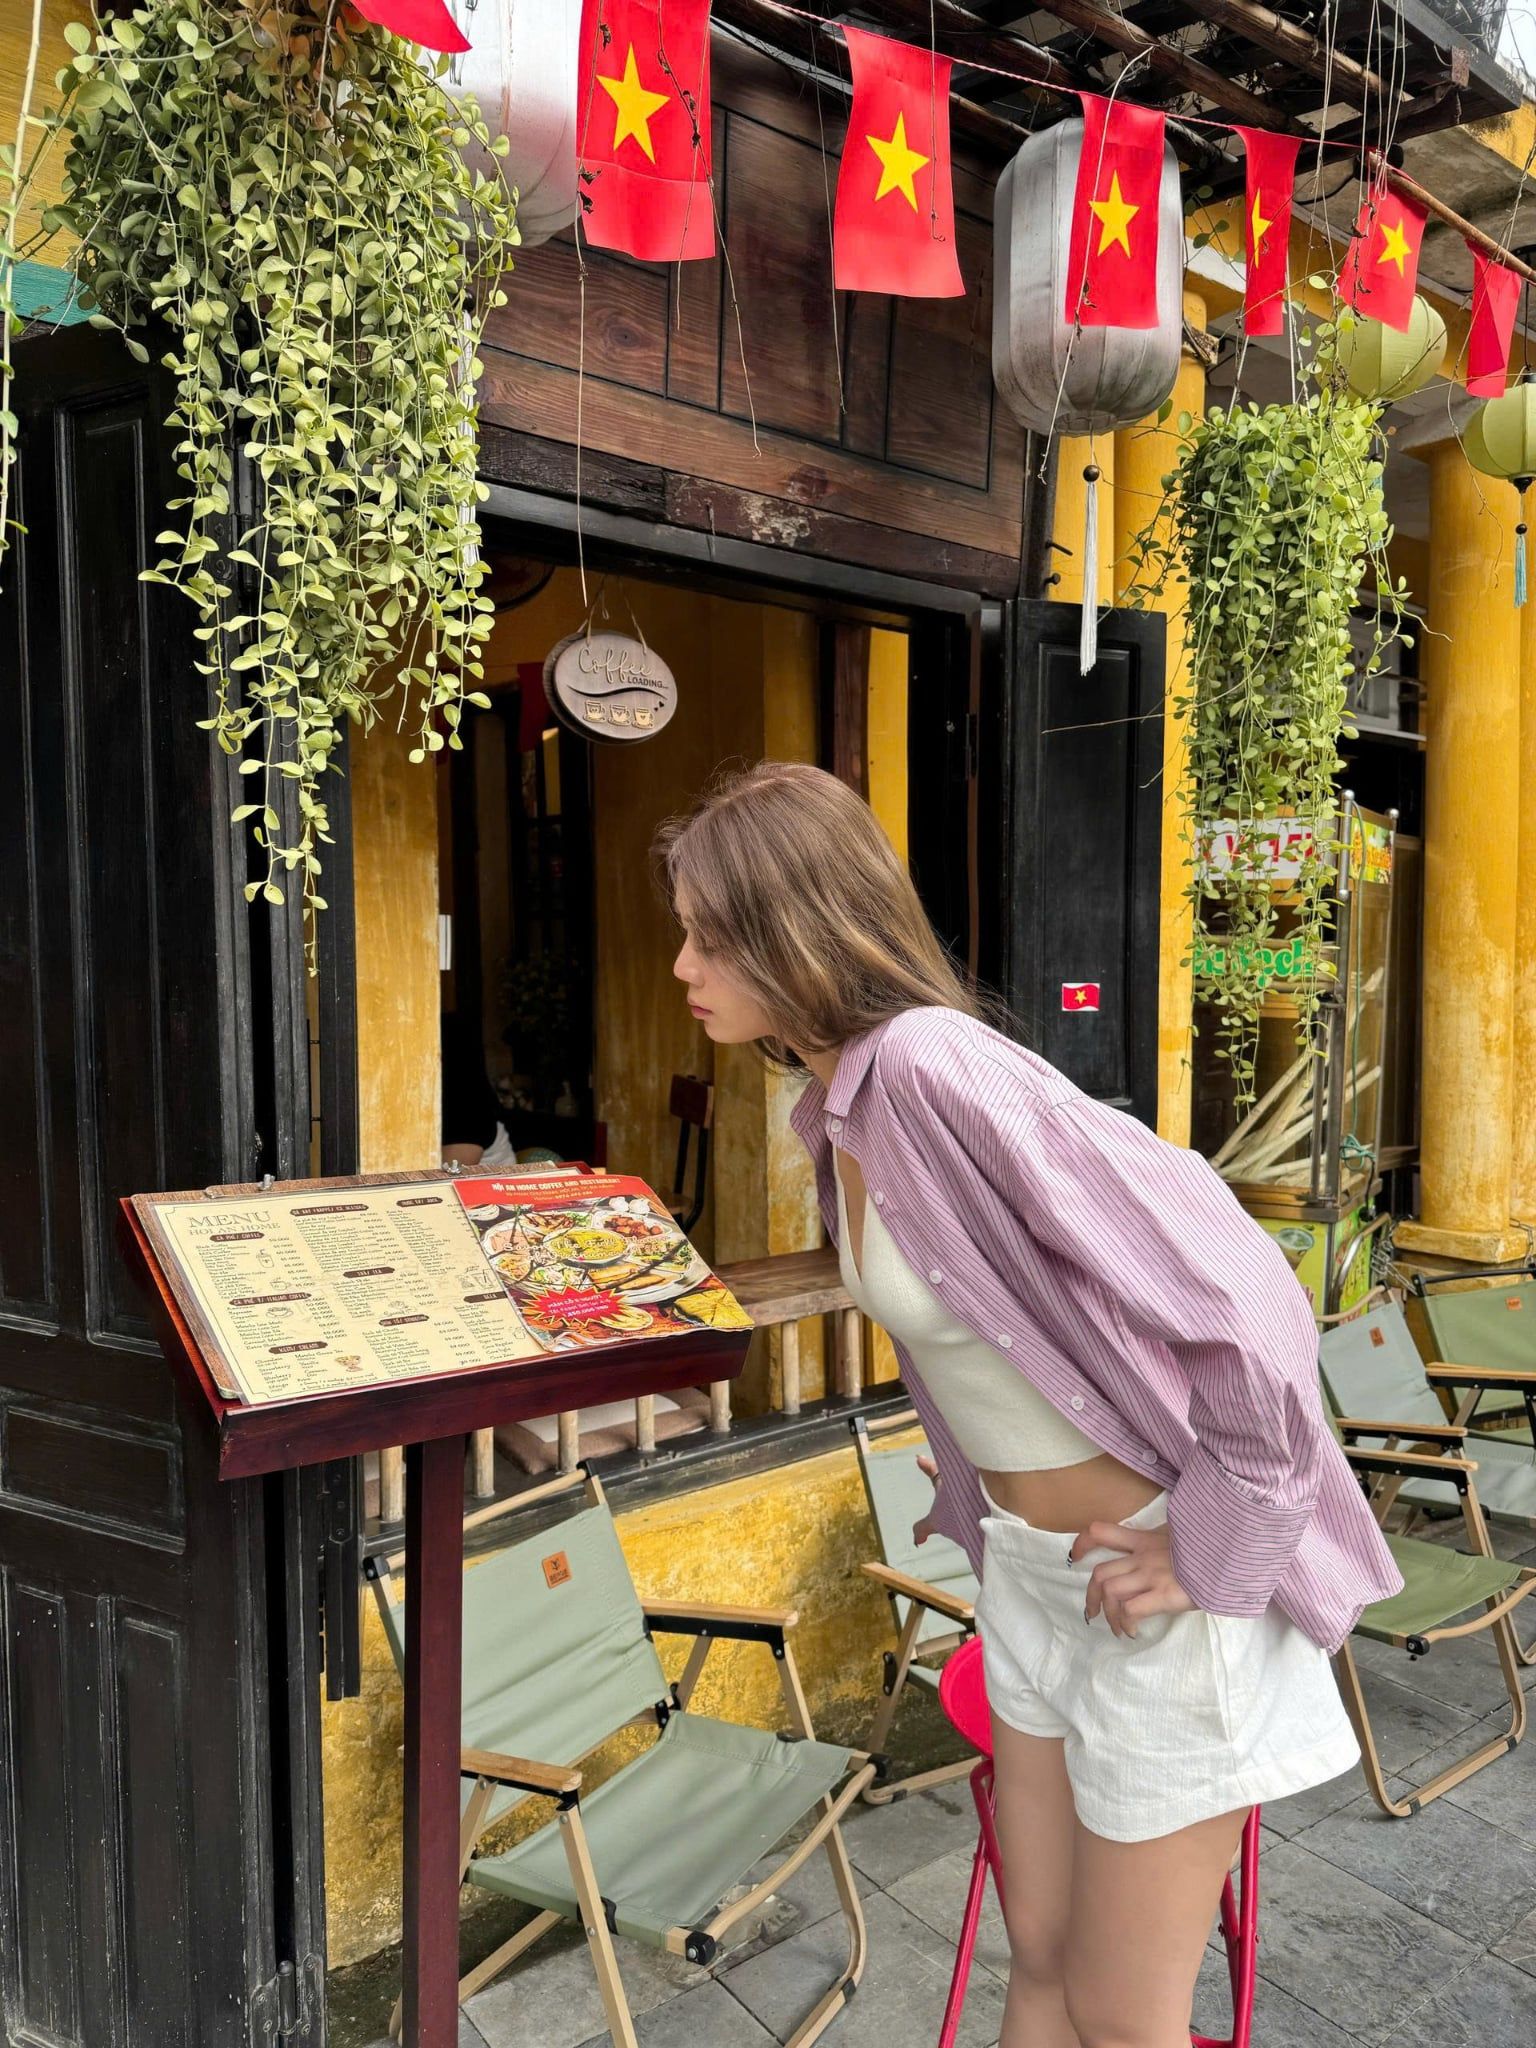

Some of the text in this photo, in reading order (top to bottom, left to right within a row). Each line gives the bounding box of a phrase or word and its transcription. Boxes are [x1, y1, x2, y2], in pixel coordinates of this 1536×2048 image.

[578, 645, 652, 684] Coffee
[538, 1181, 564, 1190] COFFEE
[189, 1211, 271, 1228] MENU
[219, 1225, 236, 1234] AN
[241, 1222, 280, 1232] HOME
